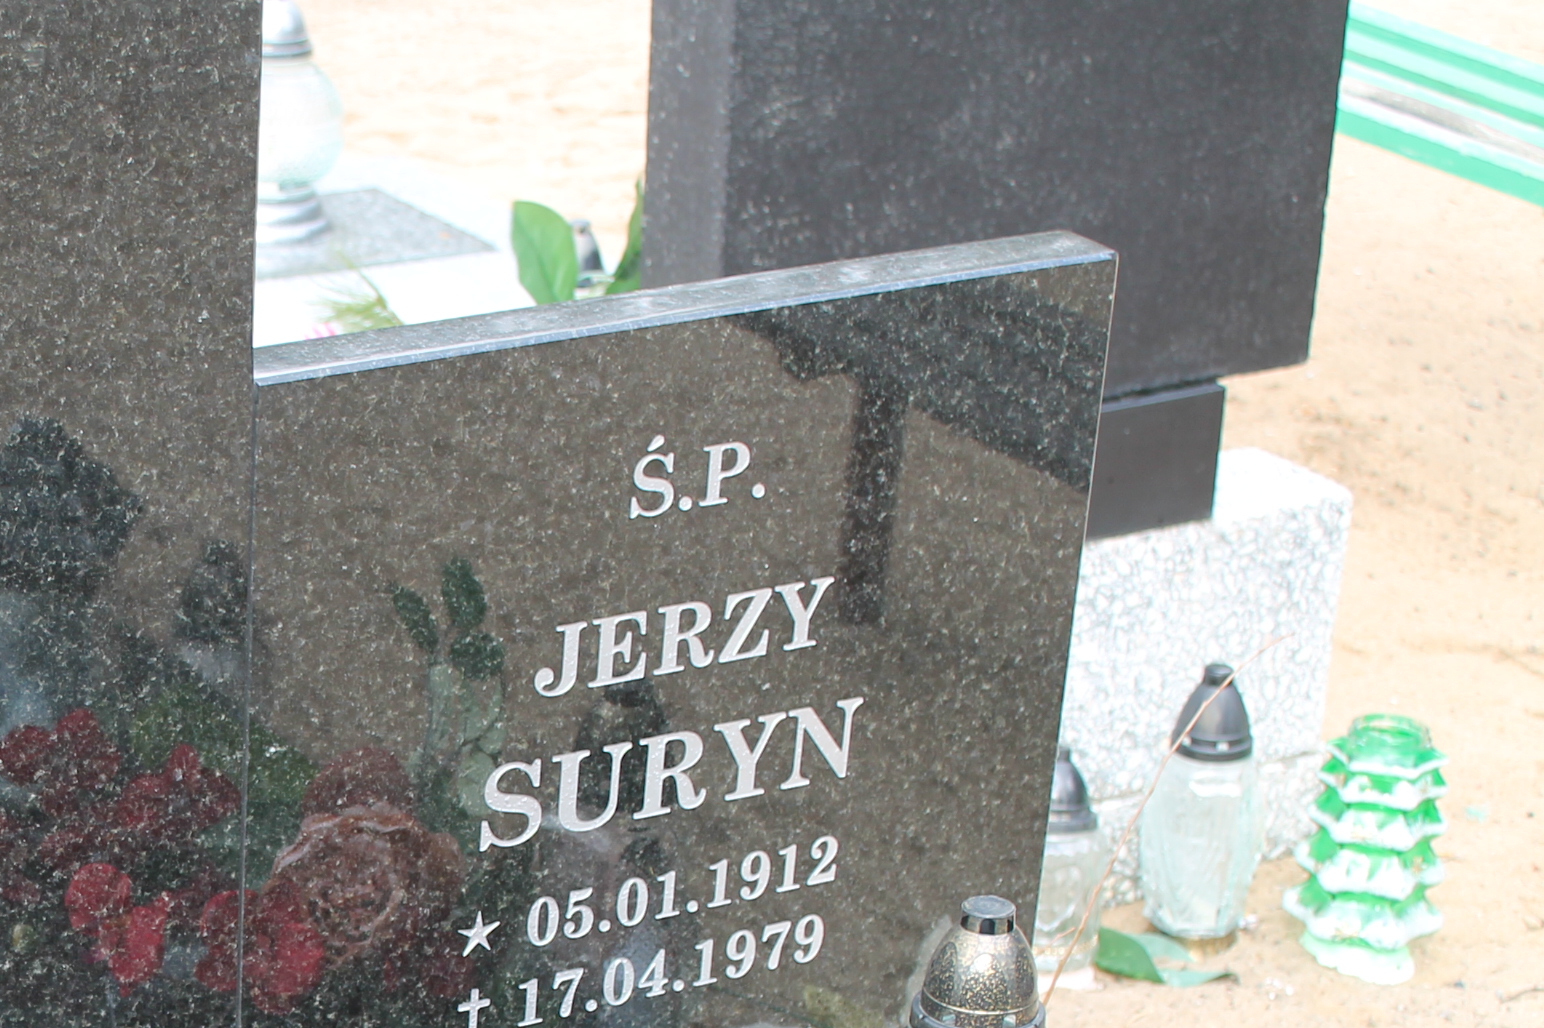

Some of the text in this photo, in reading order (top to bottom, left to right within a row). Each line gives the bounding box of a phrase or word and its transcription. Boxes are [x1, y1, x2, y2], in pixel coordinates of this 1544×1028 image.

[629, 434, 766, 519] Ś.P.
[534, 576, 835, 697] JERZY
[478, 696, 864, 853] SURYN
[526, 835, 840, 947] 05.01.1912
[516, 913, 826, 1028] 17.04.1979
